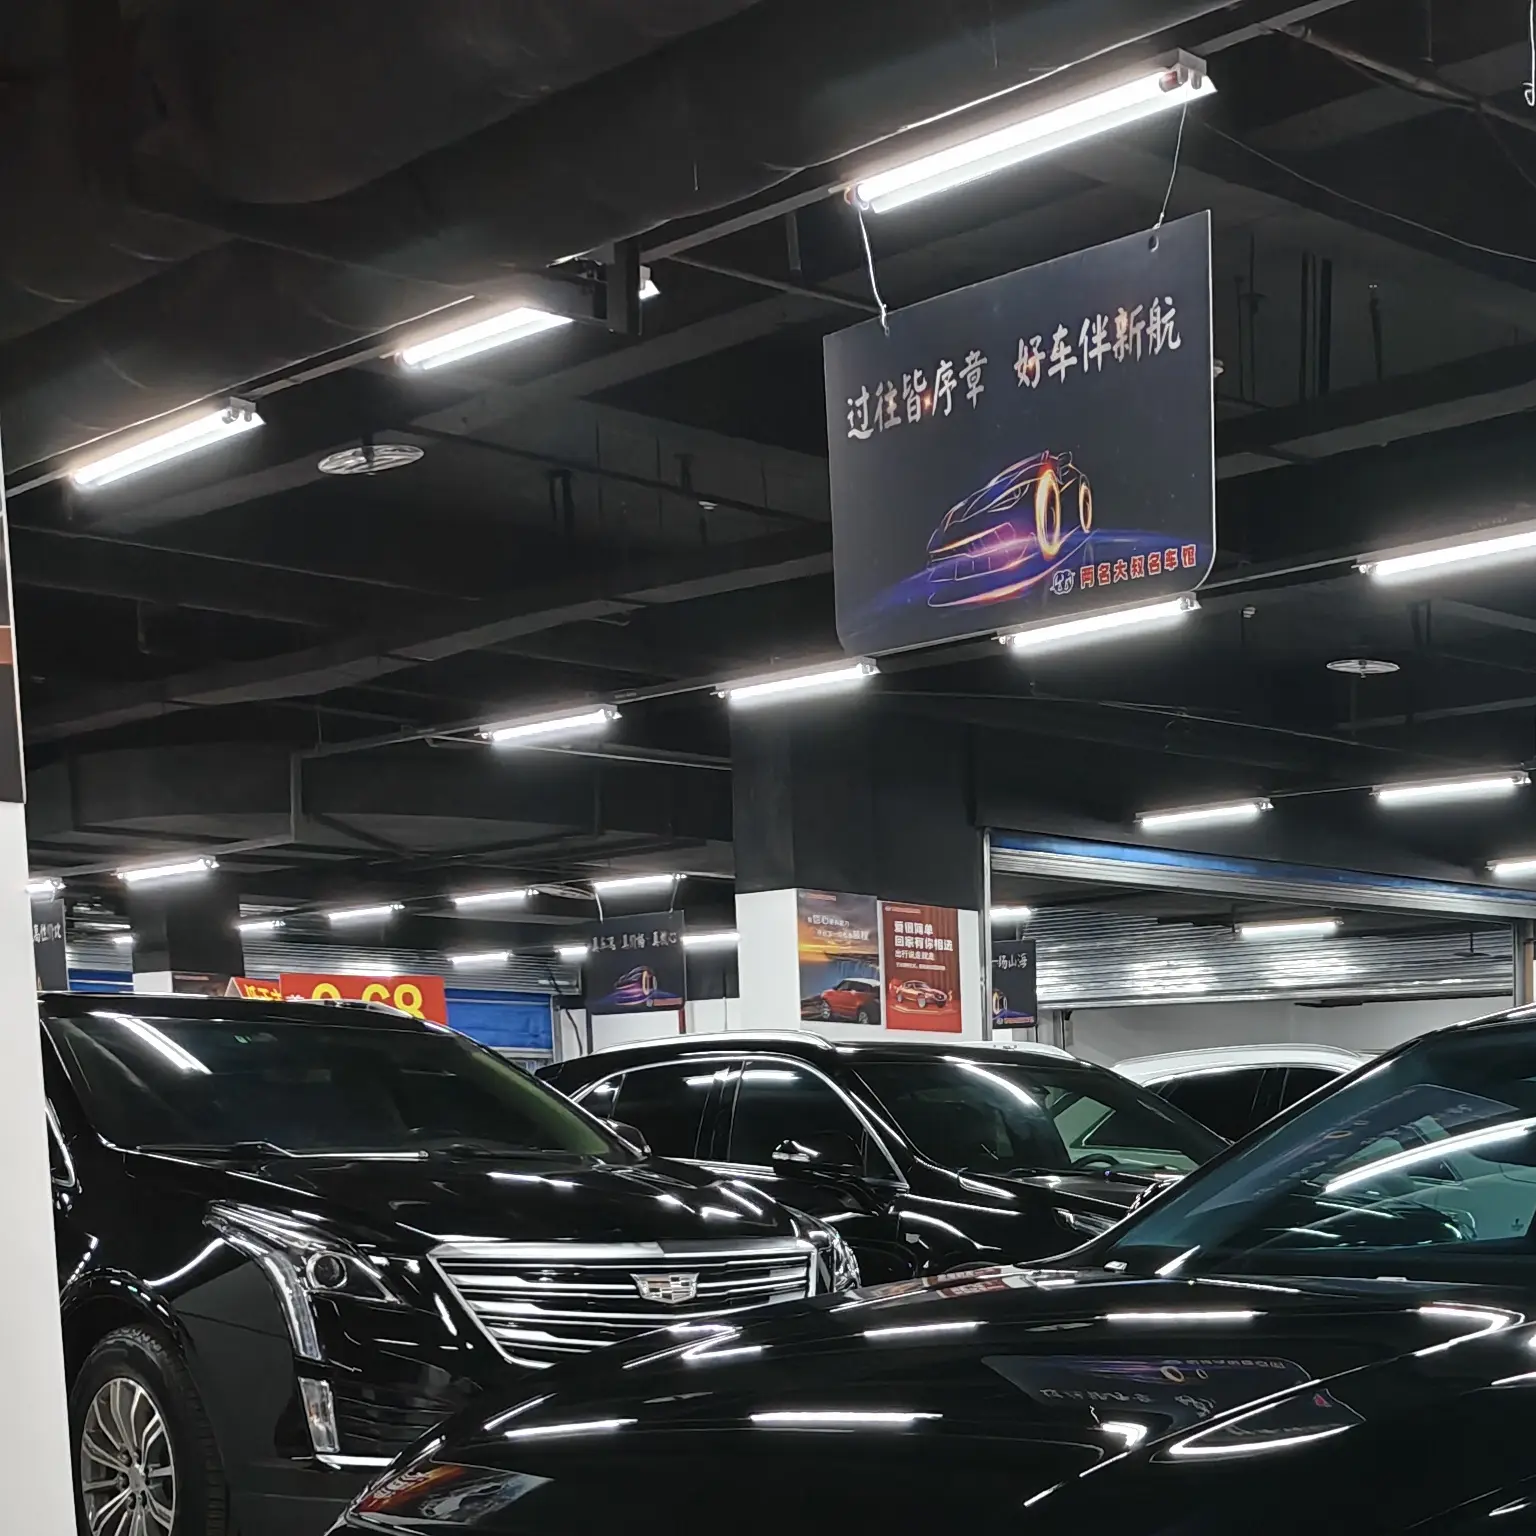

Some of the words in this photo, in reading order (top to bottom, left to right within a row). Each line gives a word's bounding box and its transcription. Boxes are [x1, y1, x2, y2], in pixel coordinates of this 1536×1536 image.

[846, 350, 988, 440] 过往皆序章
[1013, 296, 1182, 389] 好车伴新航
[1080, 544, 1197, 589] 两名大叔名车馆
